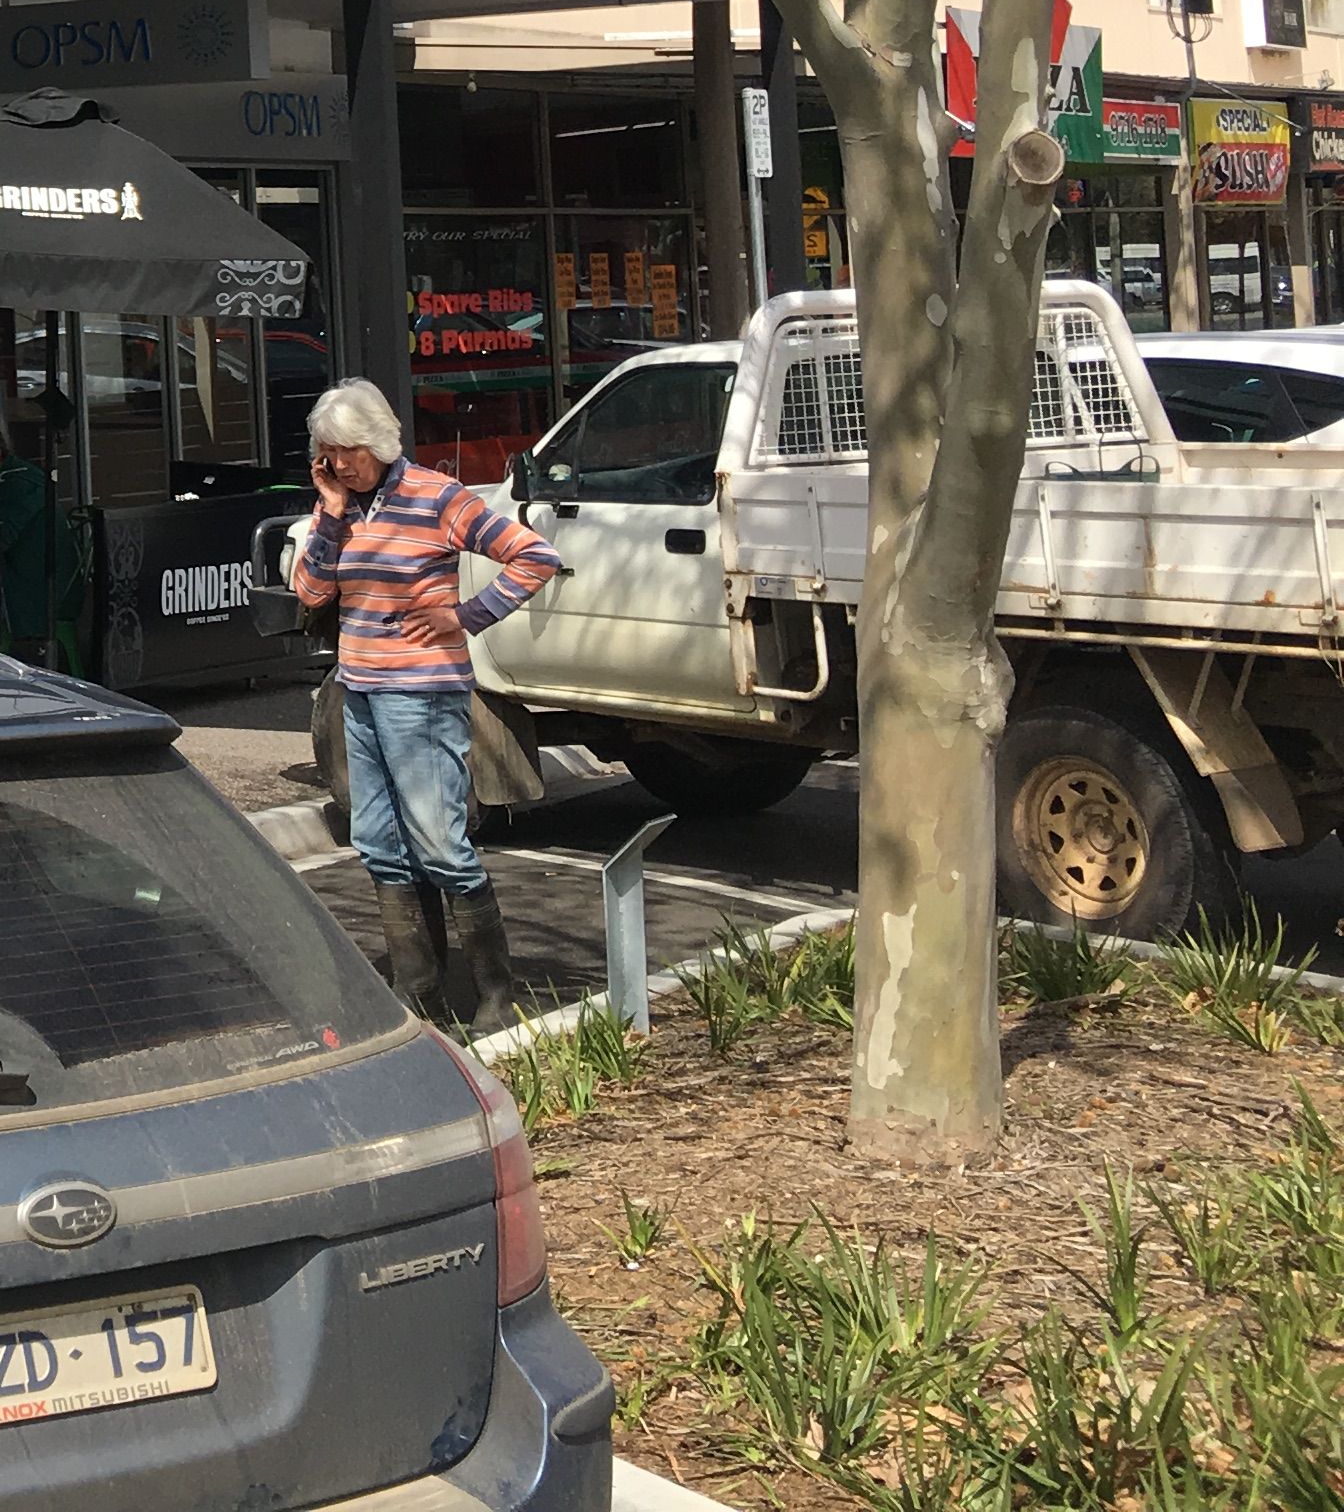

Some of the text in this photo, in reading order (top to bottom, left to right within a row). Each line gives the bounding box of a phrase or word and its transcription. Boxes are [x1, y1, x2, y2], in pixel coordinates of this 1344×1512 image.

[12, 18, 152, 68] OPSM
[243, 91, 320, 137] OPSM
[752, 94, 766, 115] 2P
[1220, 108, 1268, 132] SPECIAL
[433, 231, 465, 240] OUR
[472, 230, 533, 240] SPECIAL
[418, 289, 534, 317] Spare Ribs
[442, 329, 534, 354] Parmas
[161, 561, 253, 616] GRINDERS
[275, 1041, 320, 1058] AWD
[359, 1243, 484, 1291] LIBERTY
[101, 1304, 195, 1378] 157
[52, 1380, 170, 1412] MITSUBISHI
